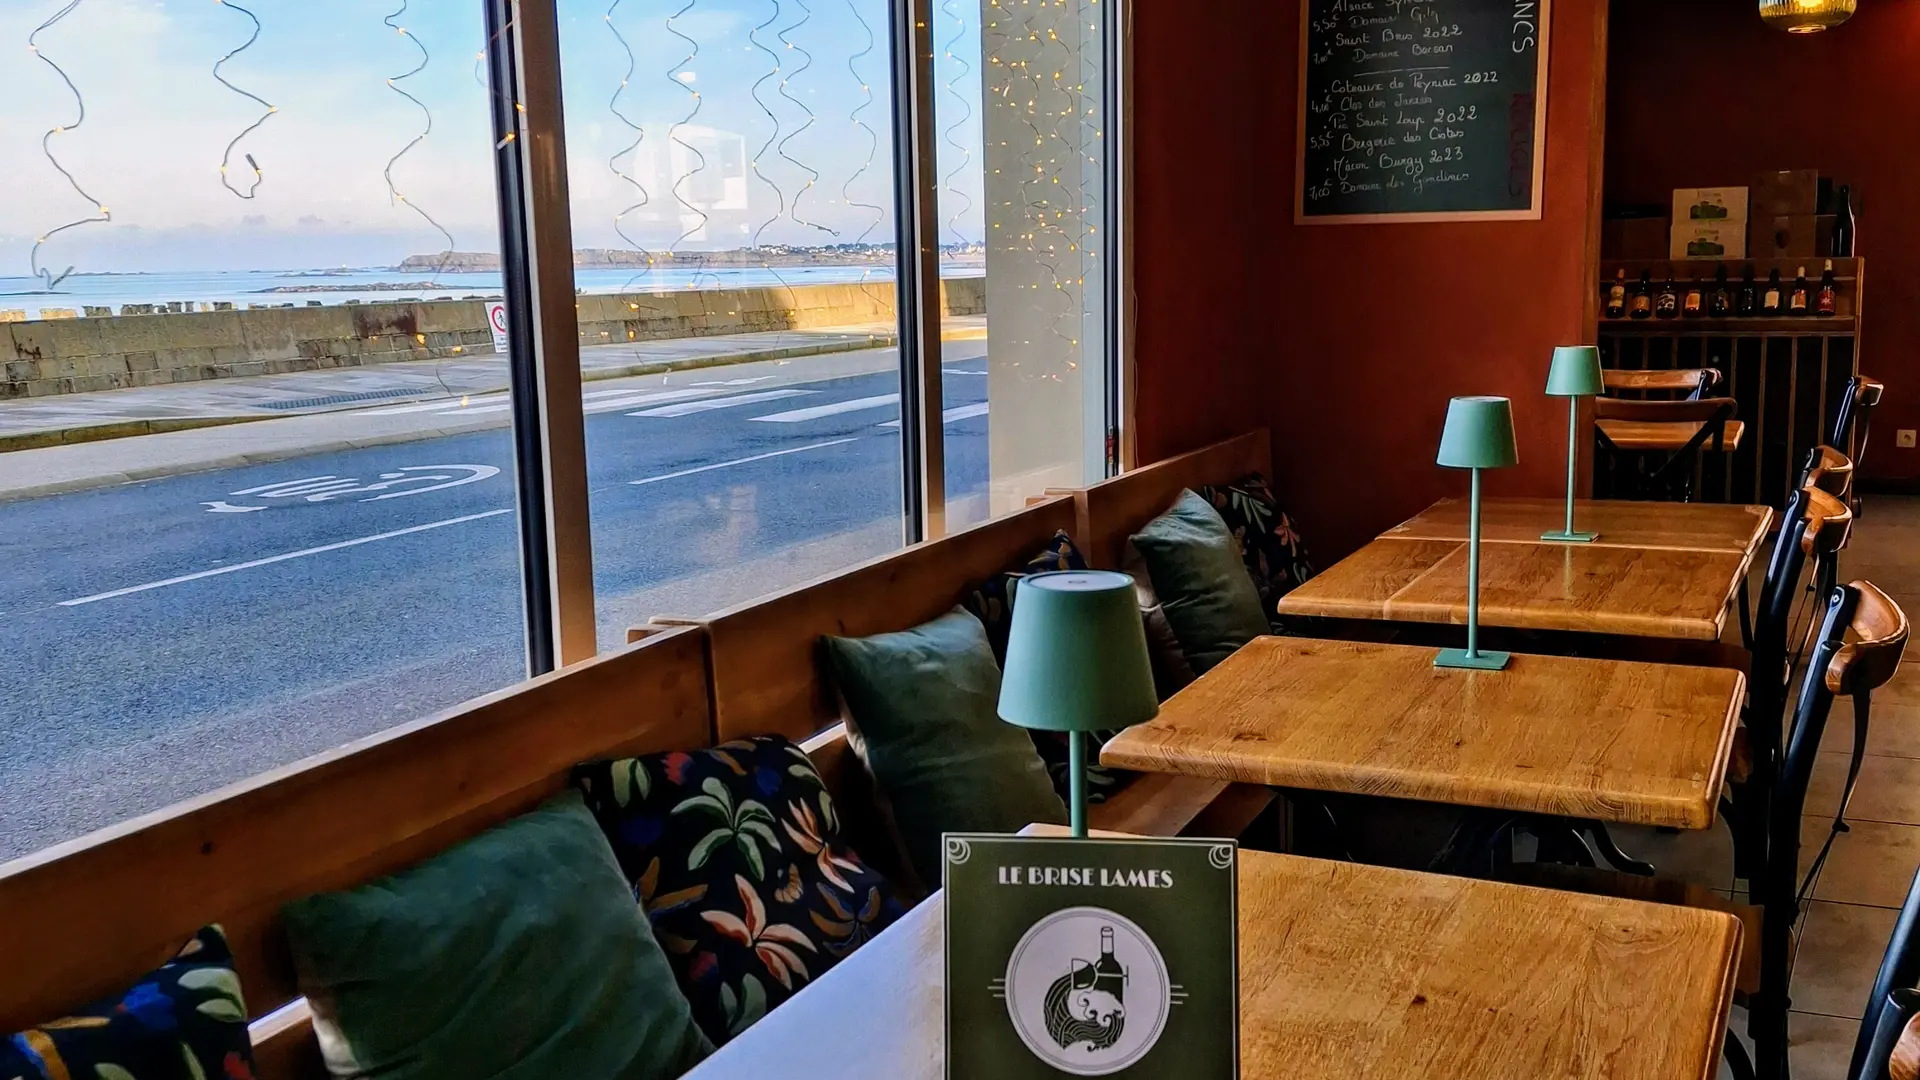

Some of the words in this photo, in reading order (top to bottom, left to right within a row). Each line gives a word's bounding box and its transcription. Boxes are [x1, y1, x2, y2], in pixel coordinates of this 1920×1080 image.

[1423, 24, 1463, 38] 2022
[1512, 0, 1535, 53] NCS
[1331, 79, 1384, 93] Coteaux
[1463, 71, 1498, 83] 2022
[1356, 112, 1389, 128] Saint
[1433, 105, 1478, 123] 2022
[1429, 146, 1464, 163] 2023
[998, 866, 1022, 885] LE
[1028, 866, 1095, 886] BRISE
[1100, 868, 1174, 888] LAMES
